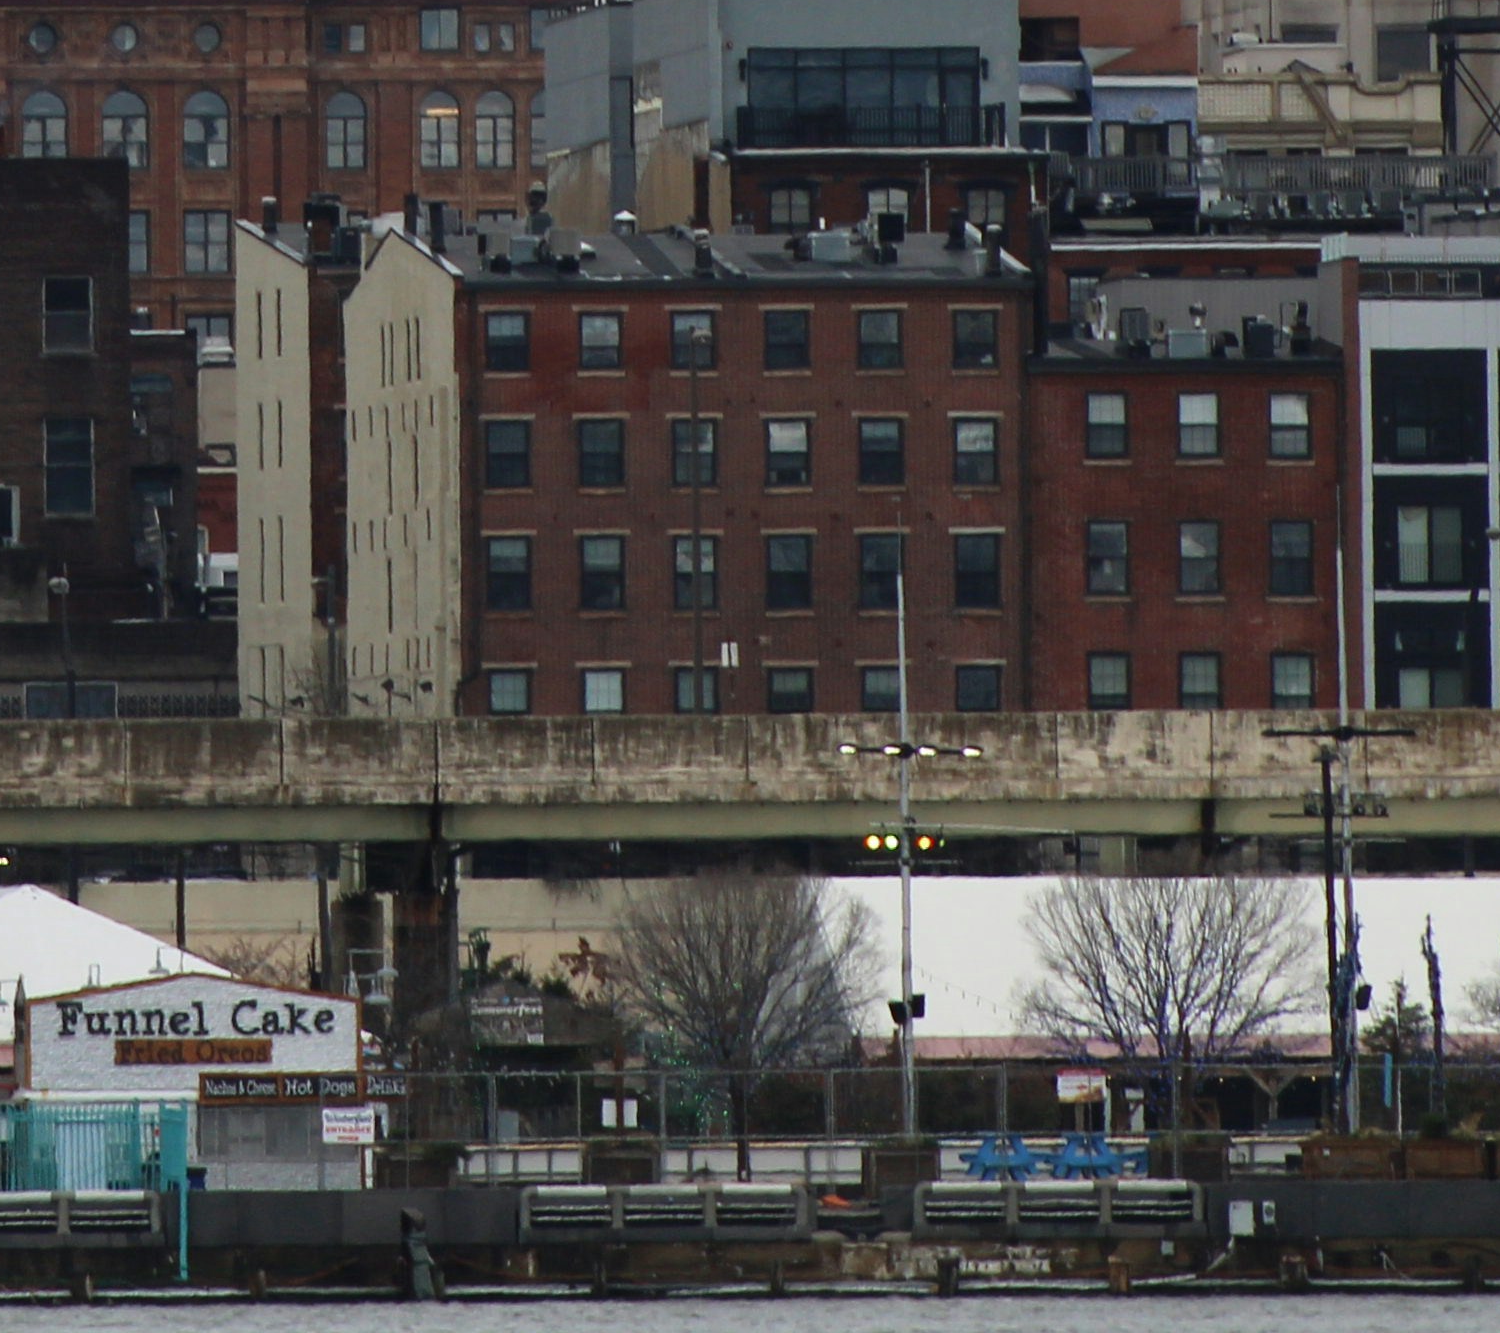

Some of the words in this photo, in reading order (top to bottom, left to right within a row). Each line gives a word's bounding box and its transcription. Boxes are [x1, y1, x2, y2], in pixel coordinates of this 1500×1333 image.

[56, 1000, 209, 1036] Funnel
[231, 999, 336, 1035] Cake
[117, 1040, 185, 1063] Fried
[196, 1041, 269, 1063] Oreos
[285, 1078, 314, 1097] Hot
[319, 1078, 356, 1098] Dogs
